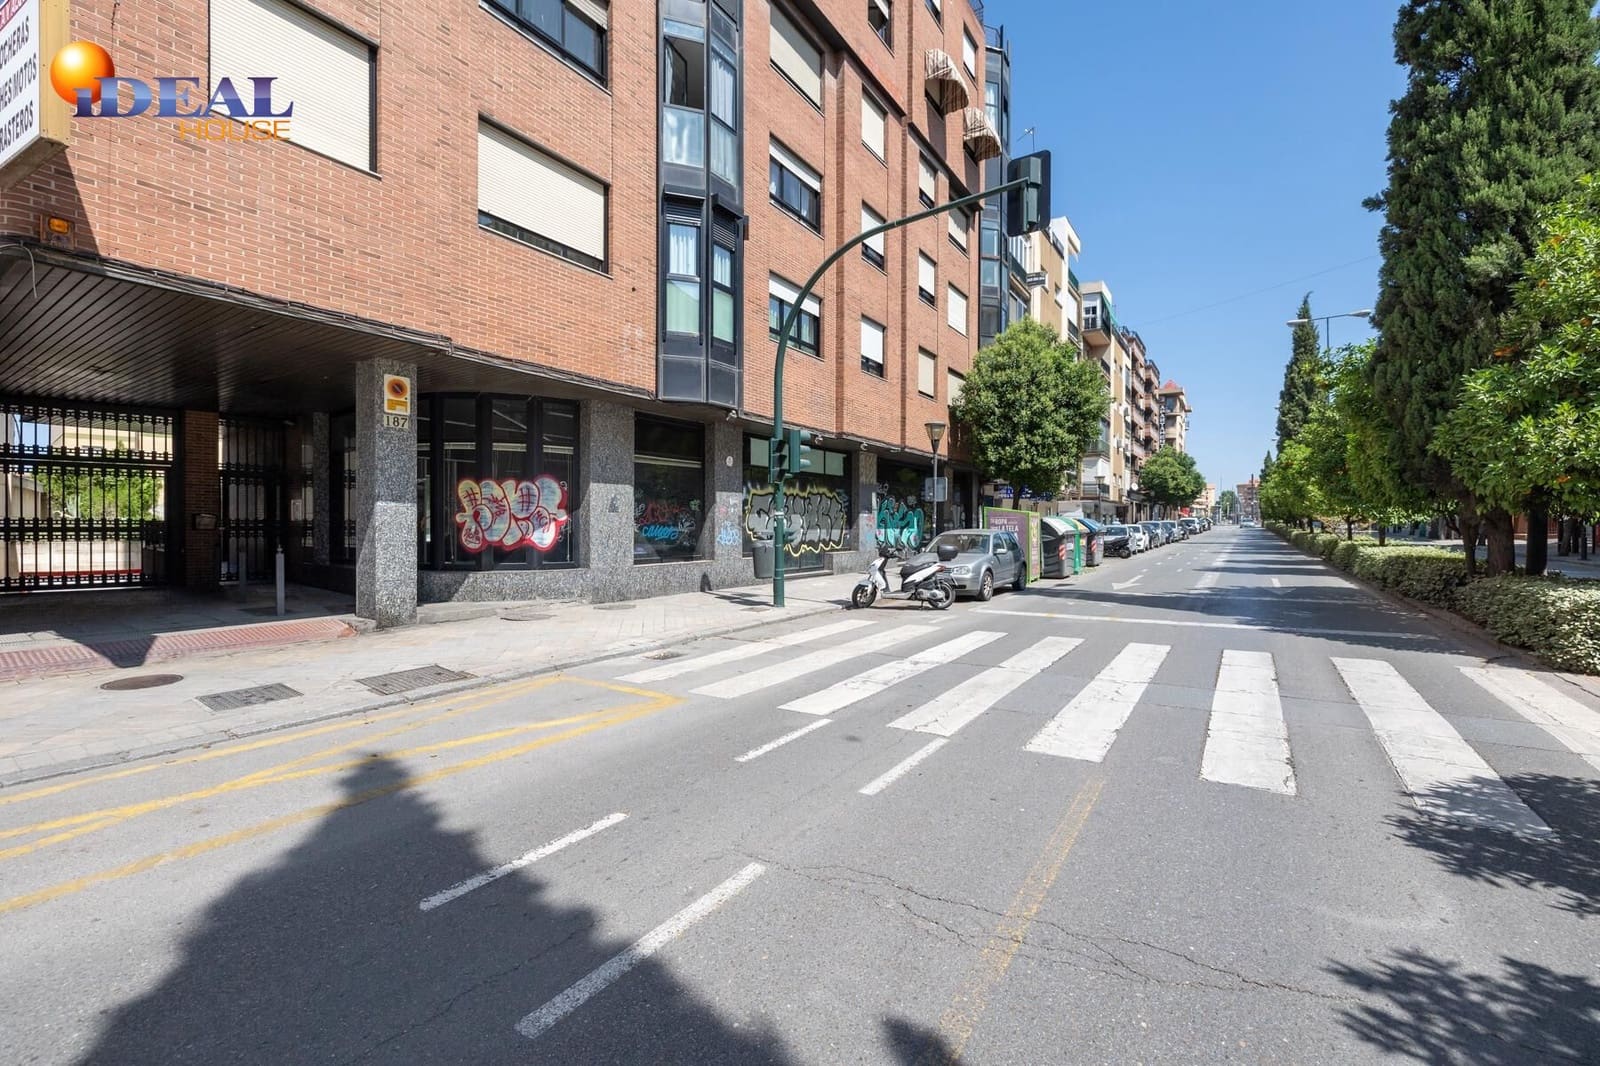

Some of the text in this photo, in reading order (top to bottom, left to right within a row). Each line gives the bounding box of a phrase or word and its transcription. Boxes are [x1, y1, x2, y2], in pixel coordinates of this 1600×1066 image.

[0, 15, 29, 70] OCHERAS
[13, 52, 37, 100] MOTOS
[0, 100, 33, 153] RASTEROS
[385, 415, 408, 428] 187
